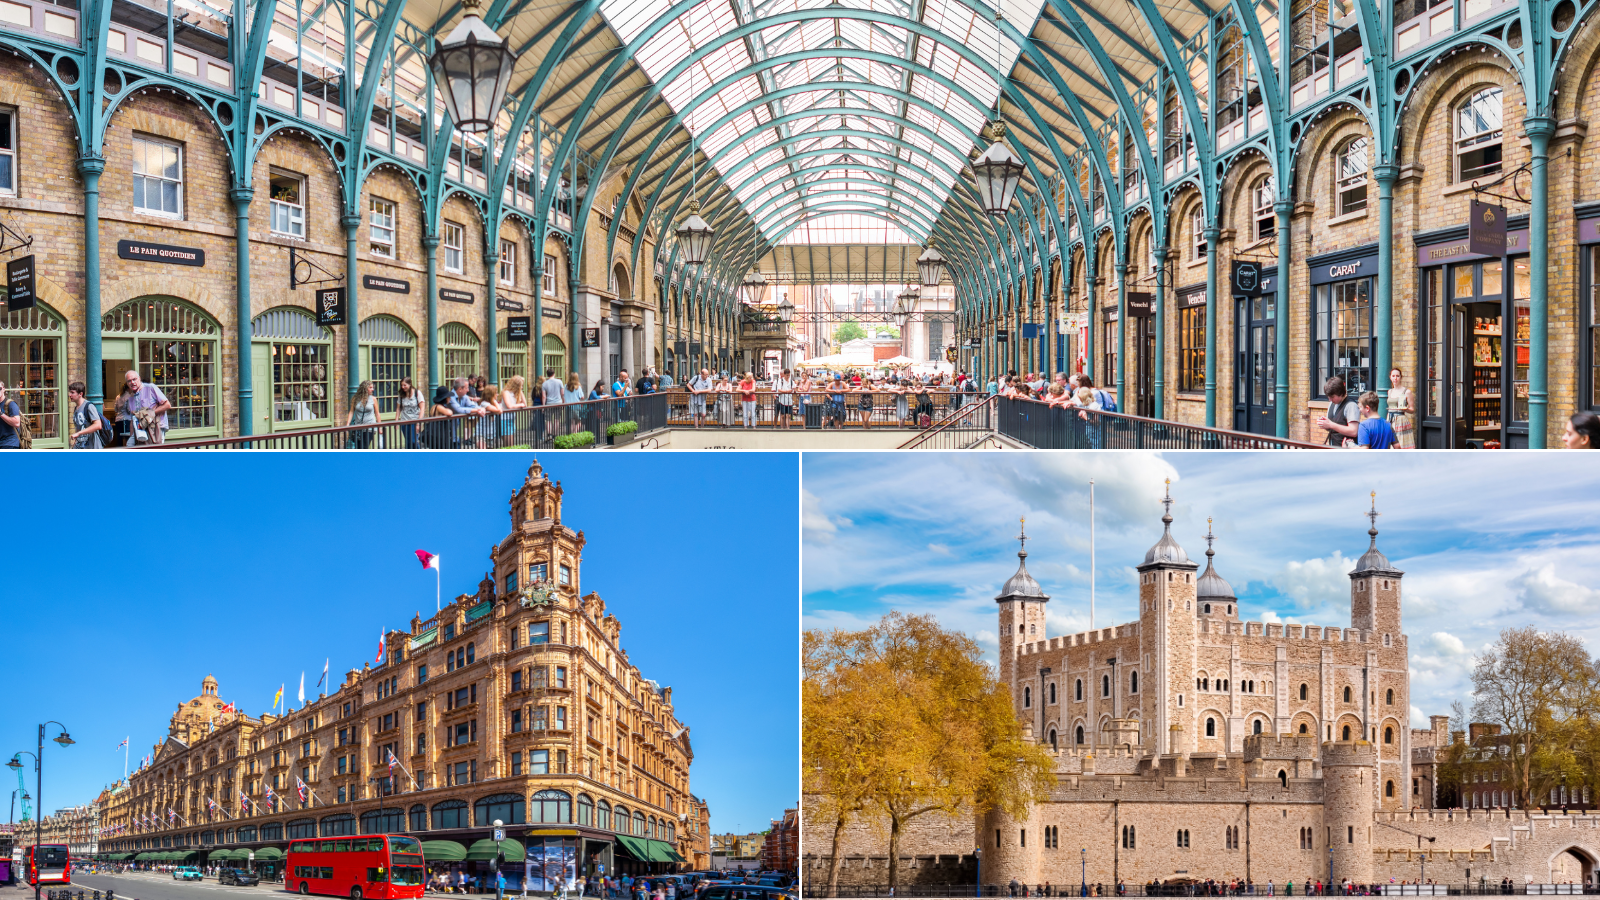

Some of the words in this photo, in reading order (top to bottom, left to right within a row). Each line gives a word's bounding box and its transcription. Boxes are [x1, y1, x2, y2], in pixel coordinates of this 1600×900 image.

[1476, 236, 1502, 244] COMPANY
[159, 249, 196, 260] QUOTIDIEN
[1430, 248, 1443, 259] THE
[1443, 246, 1460, 257] EAST
[1187, 291, 1206, 305] Venchi
